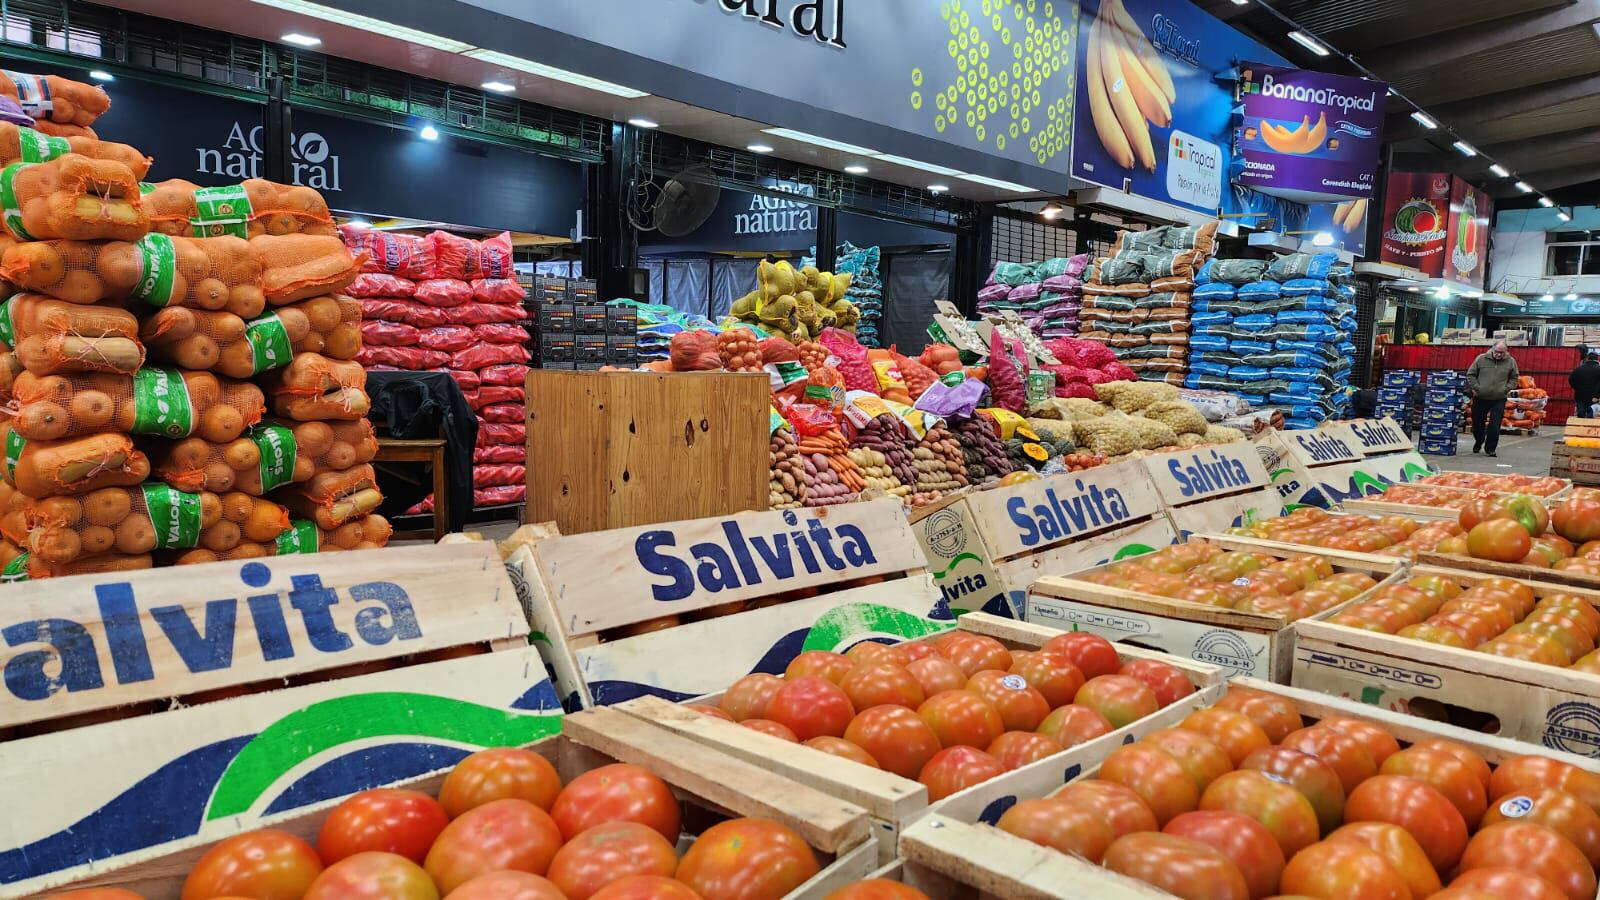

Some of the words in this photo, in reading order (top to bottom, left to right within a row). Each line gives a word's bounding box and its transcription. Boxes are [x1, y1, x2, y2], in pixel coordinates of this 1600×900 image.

[195, 148, 342, 192] natral
[1188, 143, 1216, 173] Tropical
[1322, 178, 1350, 188] Cavendish
[735, 208, 817, 234] natura
[1296, 431, 1354, 461] Salvita
[1350, 421, 1402, 447] Salvita
[1168, 449, 1251, 497] Salvita
[1006, 479, 1130, 546] Salvita
[635, 509, 876, 601] Salvita
[1, 561, 423, 700] alvita
[1197, 653, 1250, 668] A-2753-a-H
